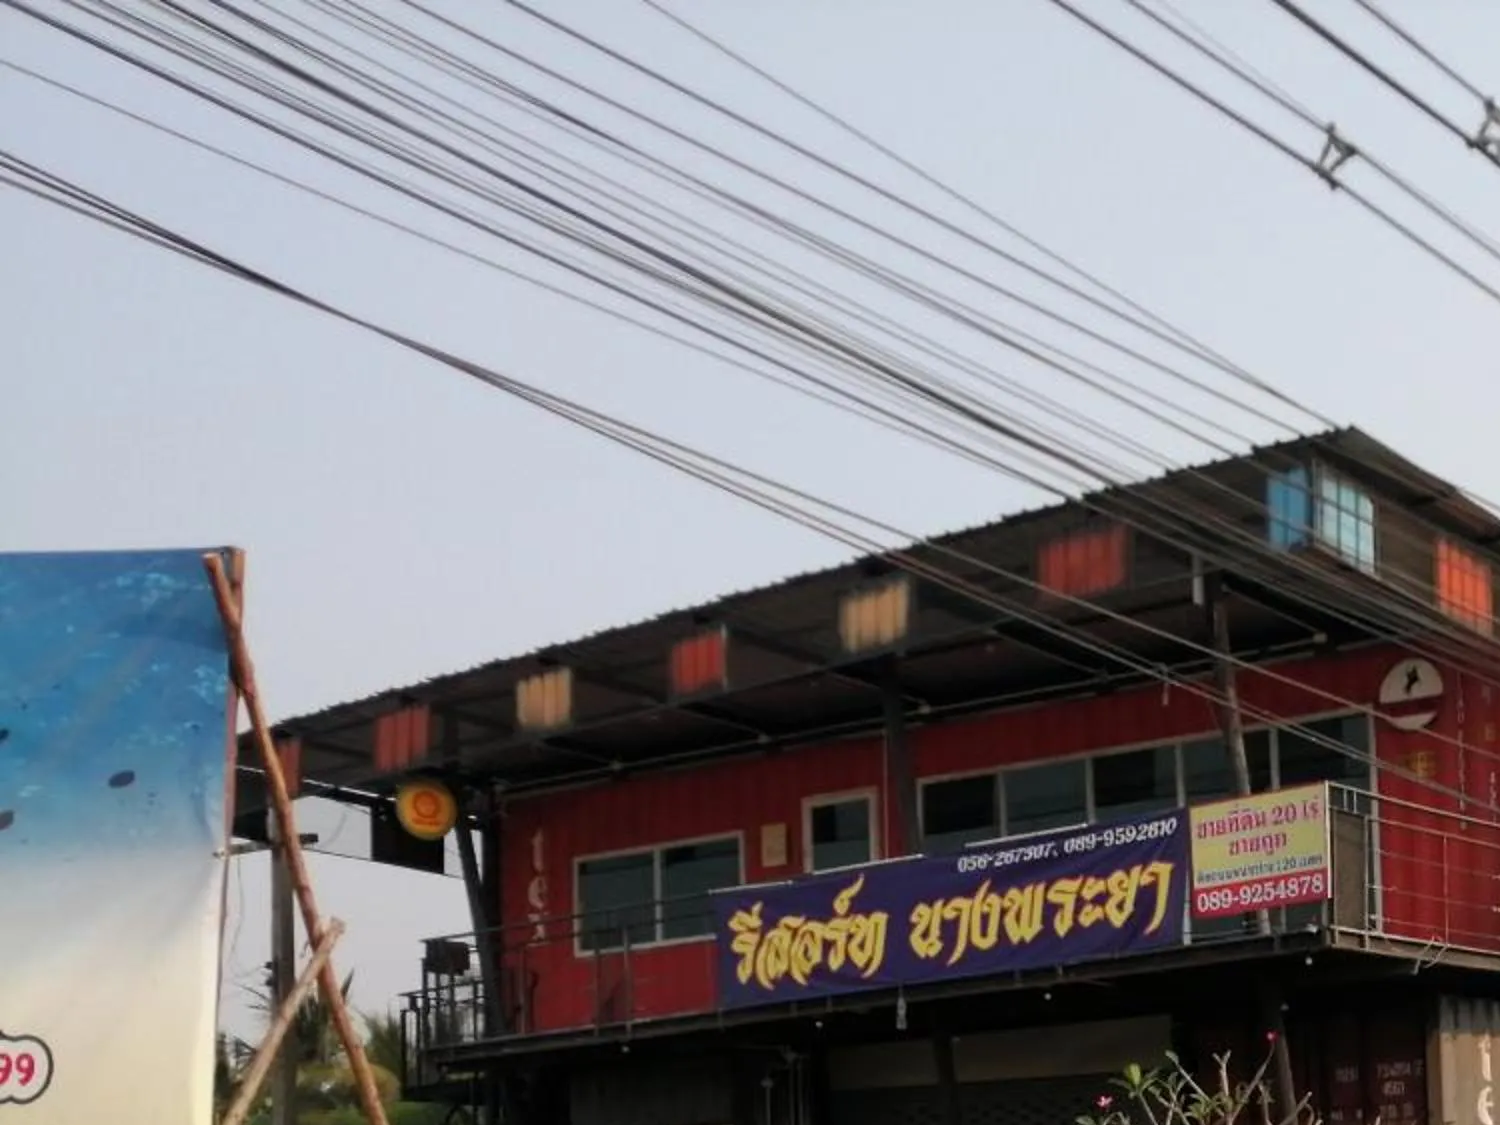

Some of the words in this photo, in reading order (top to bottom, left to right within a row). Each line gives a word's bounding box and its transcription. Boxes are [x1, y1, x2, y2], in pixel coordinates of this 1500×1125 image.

[1271, 804, 1297, 825] 20
[1197, 873, 1324, 912] 089-9254878
[909, 861, 1175, 967] นางพระยา
